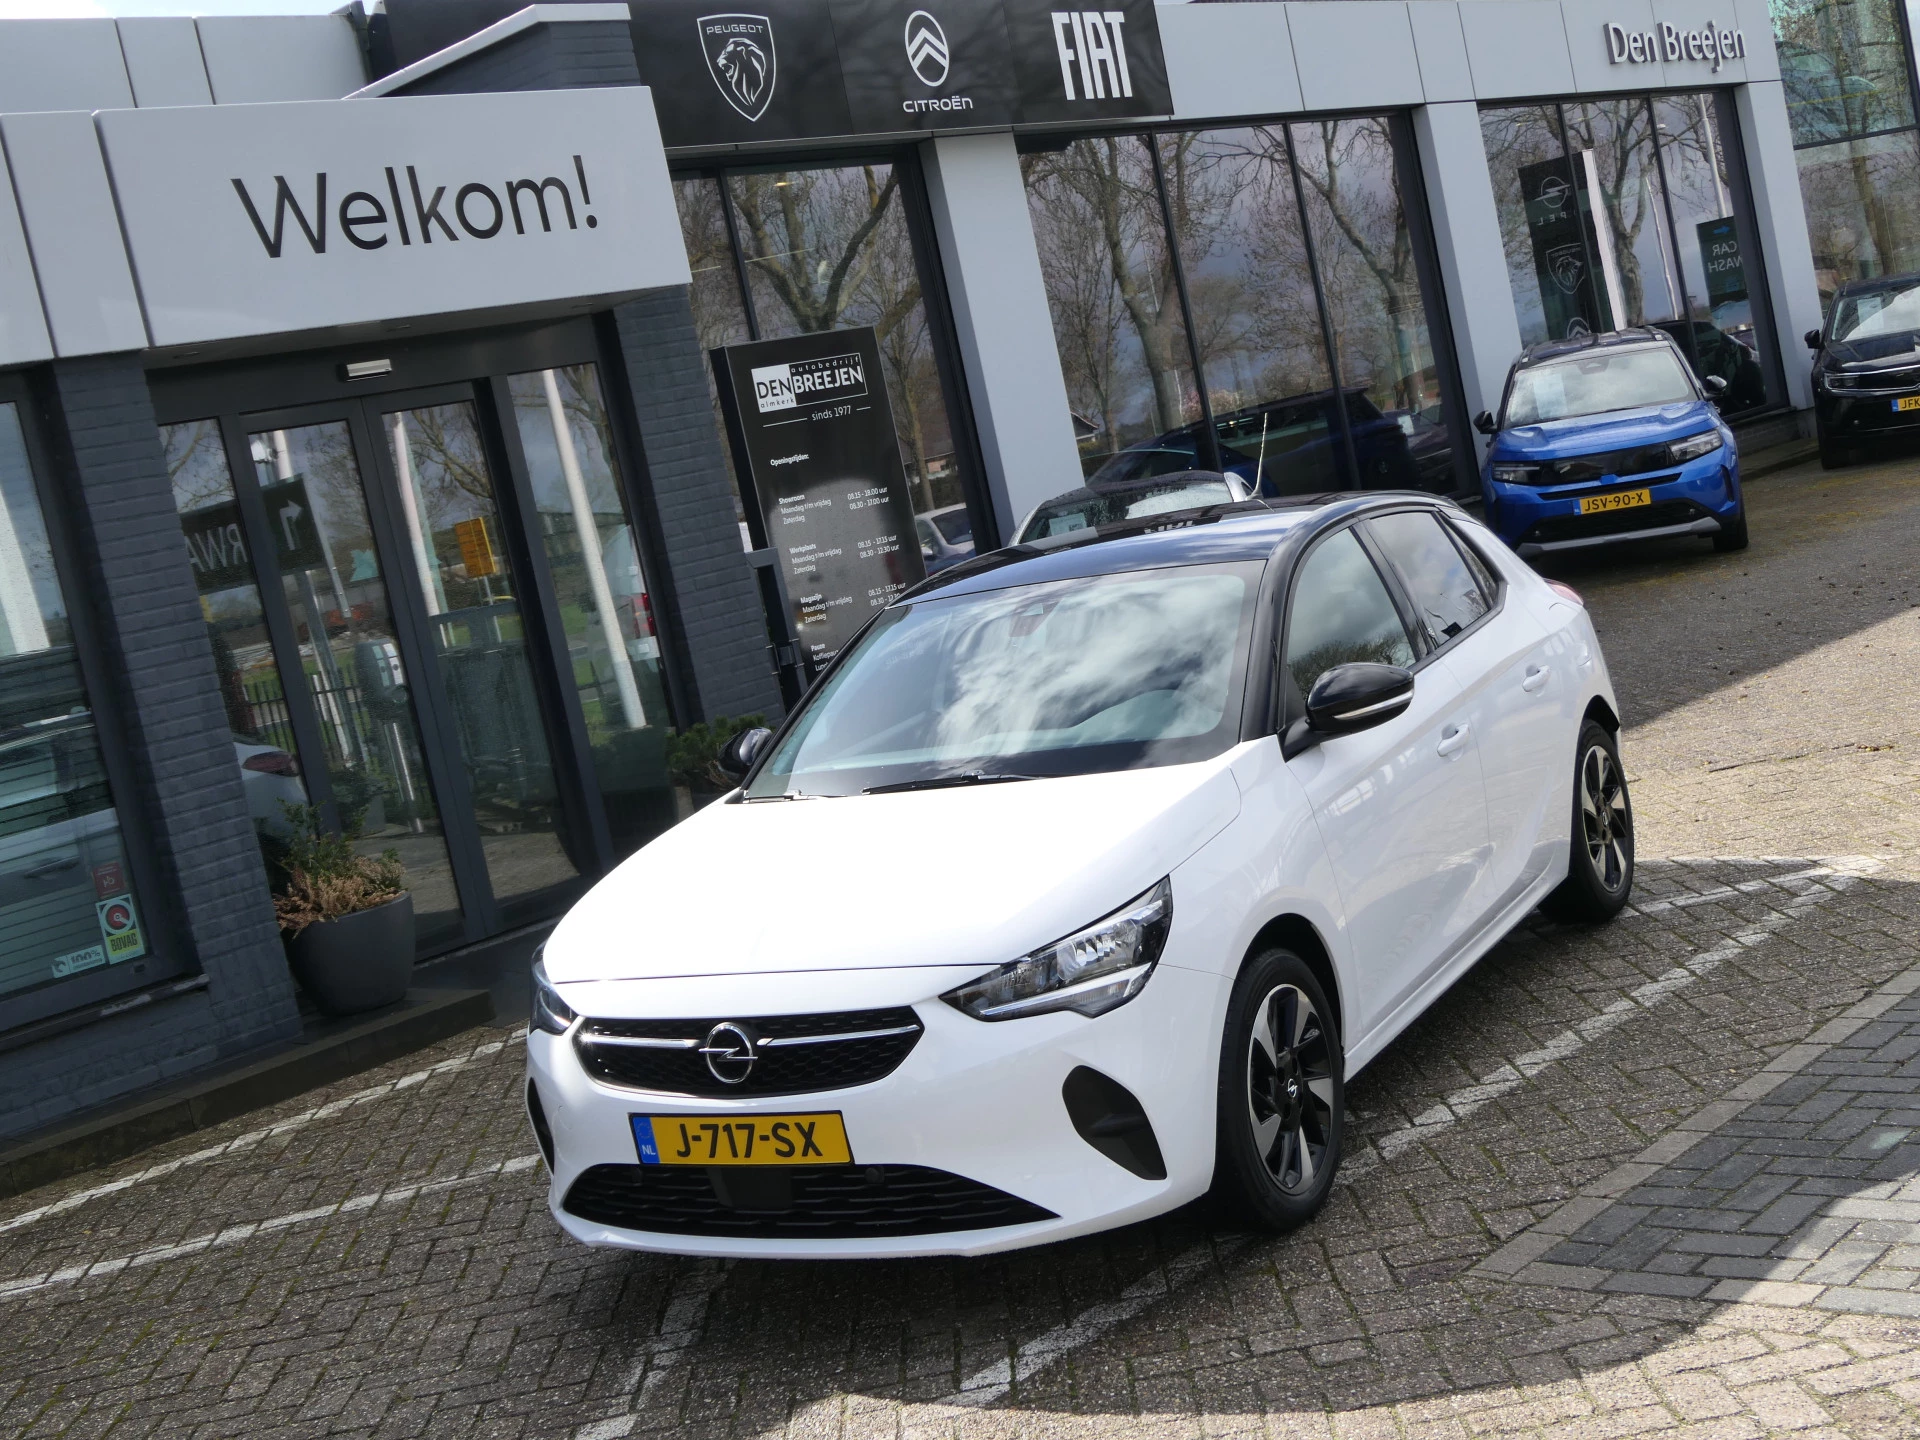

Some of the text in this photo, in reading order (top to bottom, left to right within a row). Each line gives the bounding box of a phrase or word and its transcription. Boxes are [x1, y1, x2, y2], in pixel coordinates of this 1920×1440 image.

[706, 24, 764, 35] PEUGEOT
[1603, 20, 1748, 73] Den Breejen
[1051, 11, 1133, 100] FIAT
[903, 95, 974, 113] CITROËN
[230, 154, 598, 259] Welkom!
[791, 356, 859, 373] autobedrijf
[756, 366, 864, 399] DEN BREEJEN
[760, 397, 795, 408] almkerk
[811, 405, 852, 421] sinds 1977
[1584, 492, 1645, 512] JSV-90-X
[793, 564, 816, 575] Zaterdag
[802, 602, 826, 614] Maandag
[804, 612, 827, 624] Zaterdag
[812, 649, 839, 662] Koffiepau
[110, 932, 138, 952] BOVAG
[642, 1121, 823, 1158] NL J-717-SX
